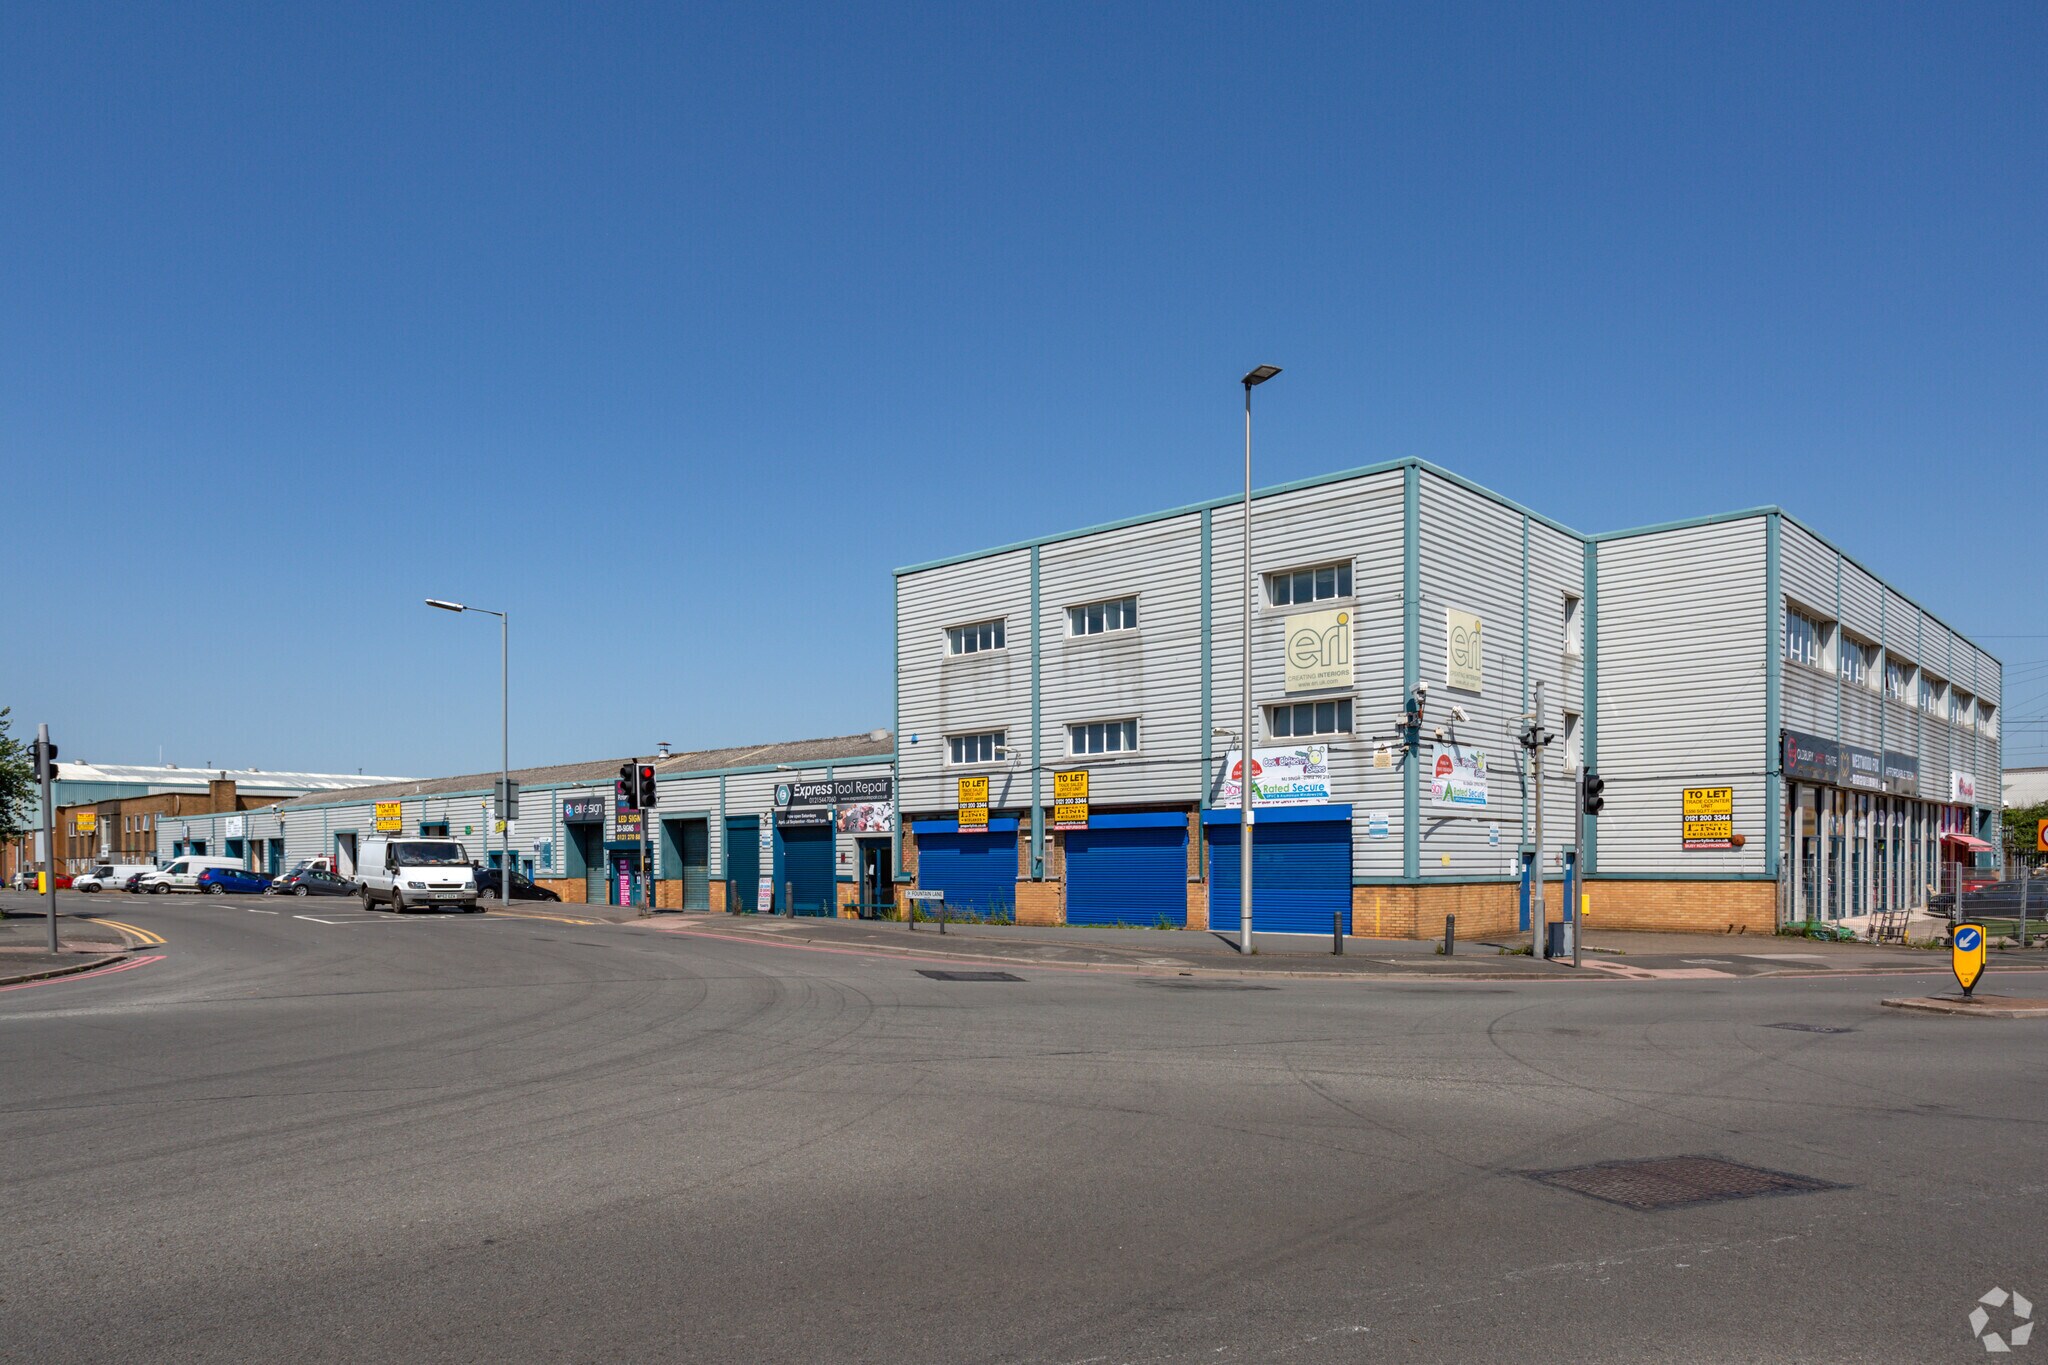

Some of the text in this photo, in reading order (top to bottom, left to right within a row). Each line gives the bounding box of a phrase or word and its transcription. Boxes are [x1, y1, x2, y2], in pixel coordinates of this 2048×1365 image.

[1288, 612, 1348, 669] eri
[1318, 670, 1350, 678] INTERIORS
[794, 784, 832, 799] Express
[834, 782, 853, 794] Tool
[856, 780, 888, 795] Repair
[1264, 784, 1289, 792] Rated
[1292, 783, 1325, 792] Secure
[618, 815, 627, 823] LED
